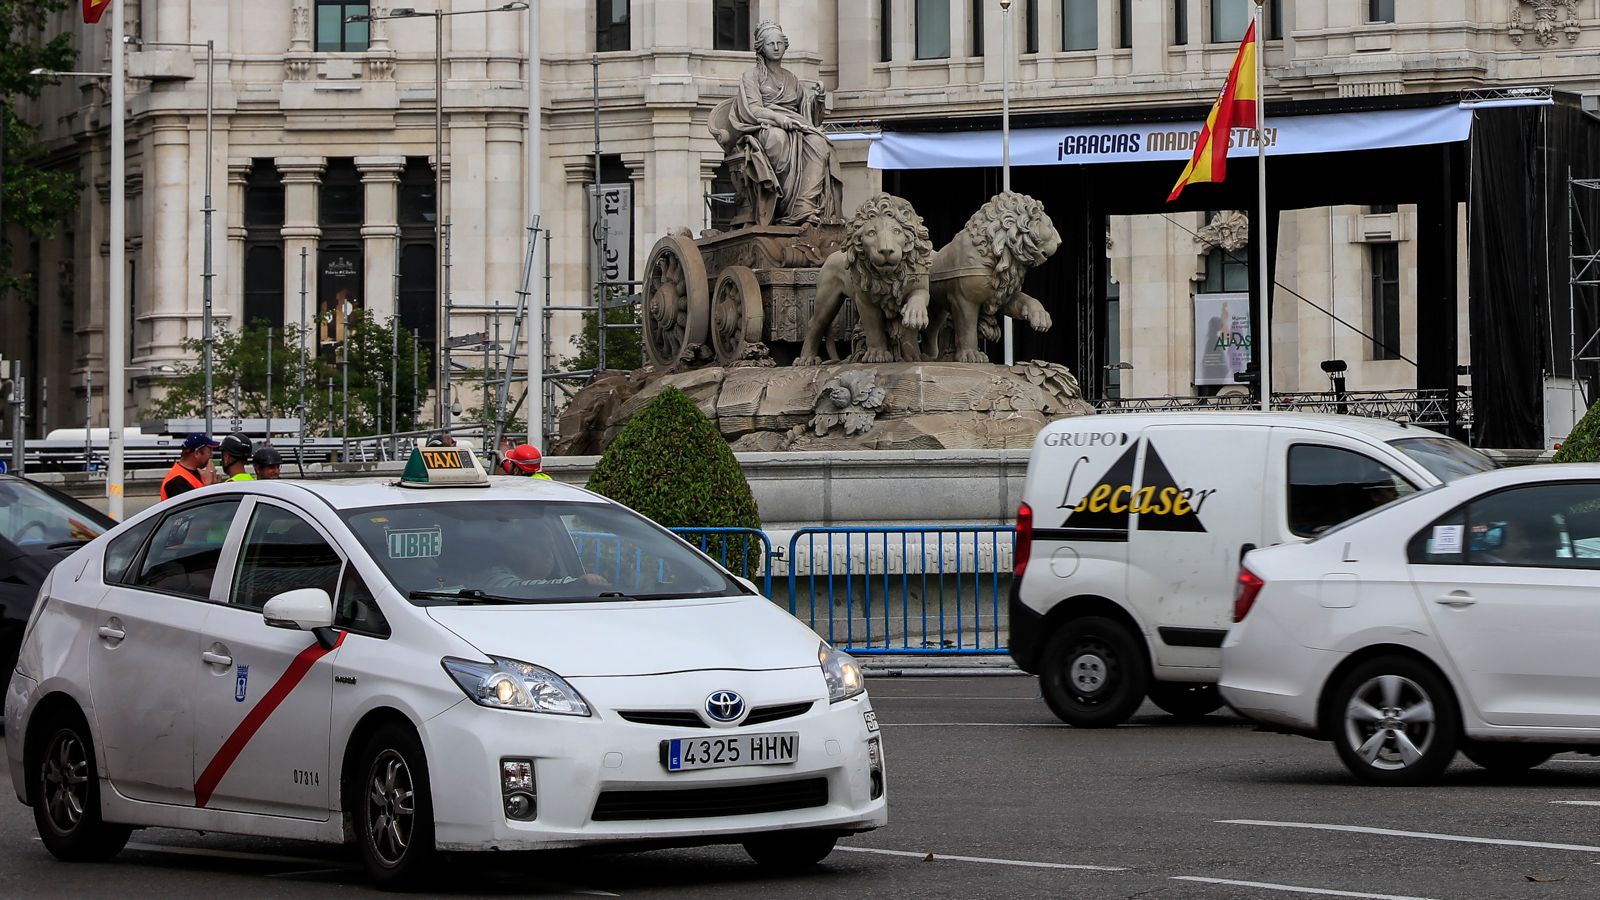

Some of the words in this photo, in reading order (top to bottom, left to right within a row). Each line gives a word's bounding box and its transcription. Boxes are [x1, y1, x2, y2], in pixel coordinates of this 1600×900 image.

[1057, 133, 1141, 161] ¡GRACIAS
[1044, 432, 1116, 447] GRUPO
[424, 452, 461, 468] TAXI
[1056, 456, 1217, 516] Lecaser
[390, 533, 439, 557] LIBRE
[672, 757, 678, 765] E
[684, 738, 740, 765] 4325
[750, 735, 794, 761] HHN
[293, 768, 320, 786] 07314
